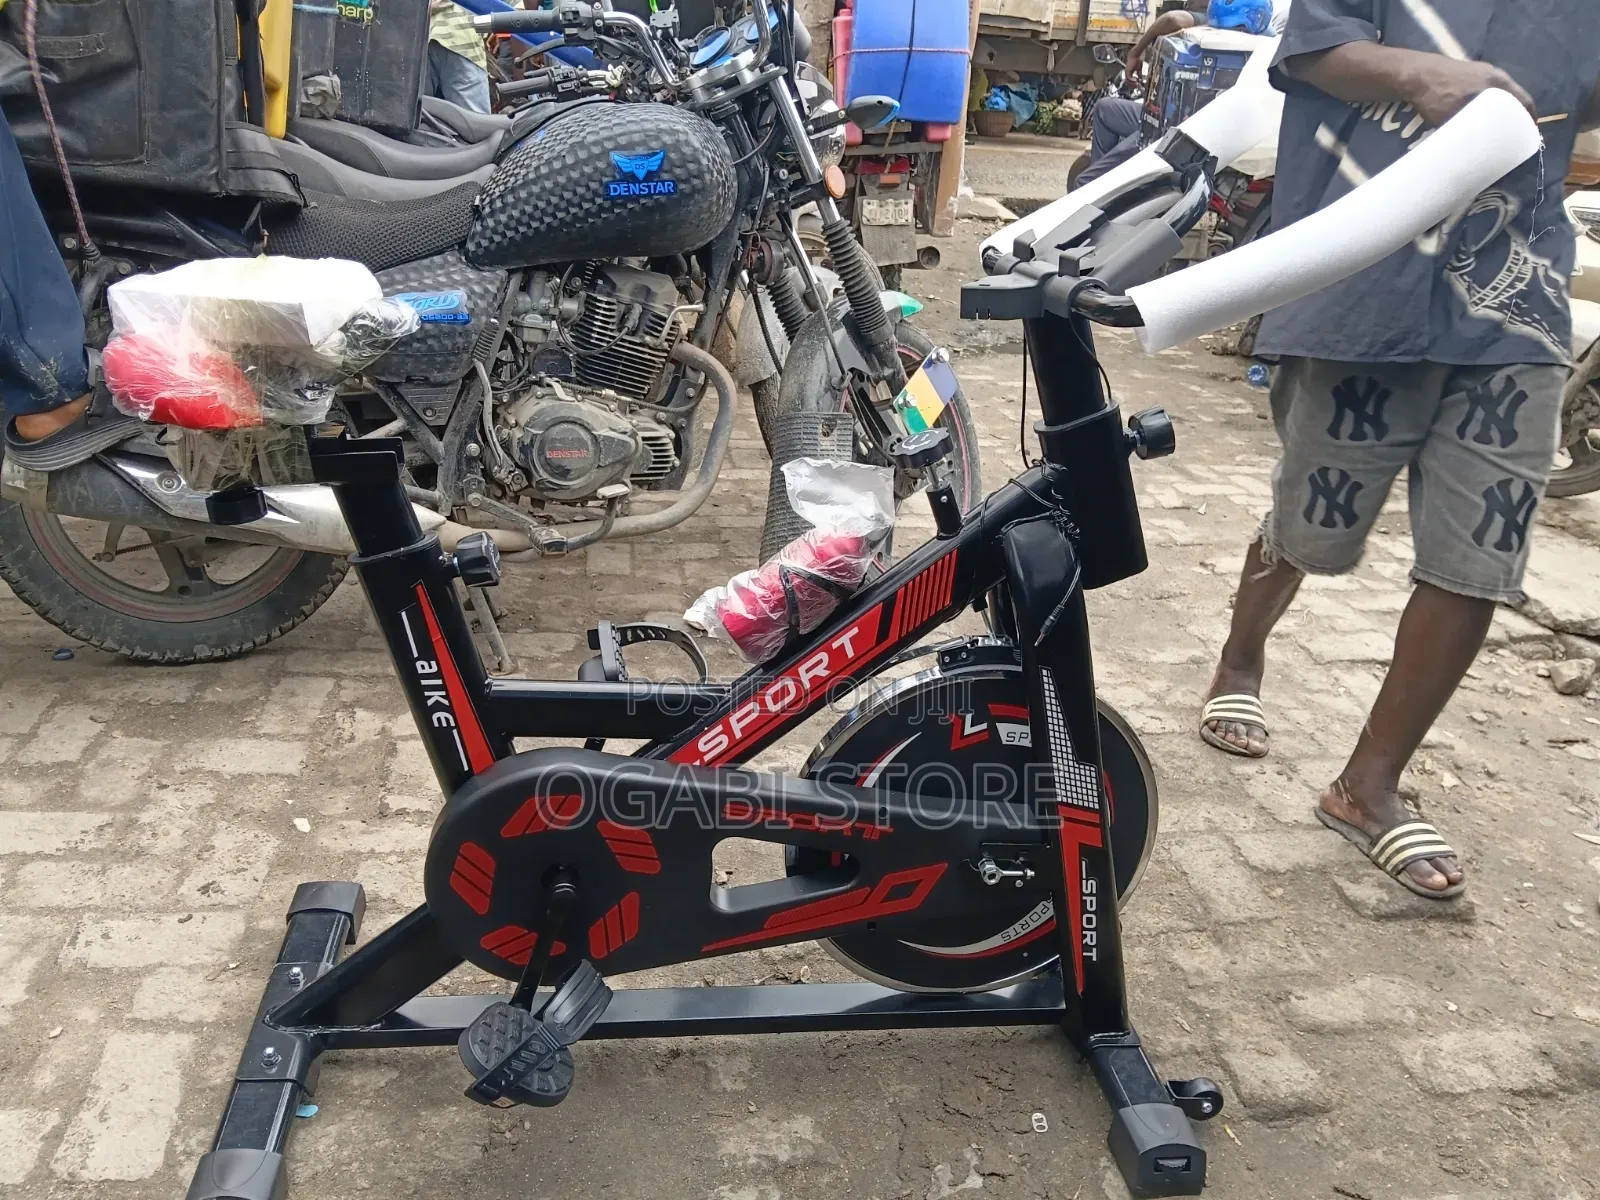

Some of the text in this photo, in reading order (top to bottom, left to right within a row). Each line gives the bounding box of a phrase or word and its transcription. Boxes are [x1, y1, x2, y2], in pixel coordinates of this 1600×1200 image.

[609, 181, 674, 196] DENSTAR
[1327, 375, 1393, 442] NY
[1456, 374, 1529, 449] NY
[546, 449, 589, 458] DENSTAR
[1303, 466, 1364, 530] NY
[1472, 477, 1538, 554] NY
[697, 626, 860, 763] SPORT
[1005, 731, 1032, 744] SP
[1081, 879, 1097, 961] SPORT
